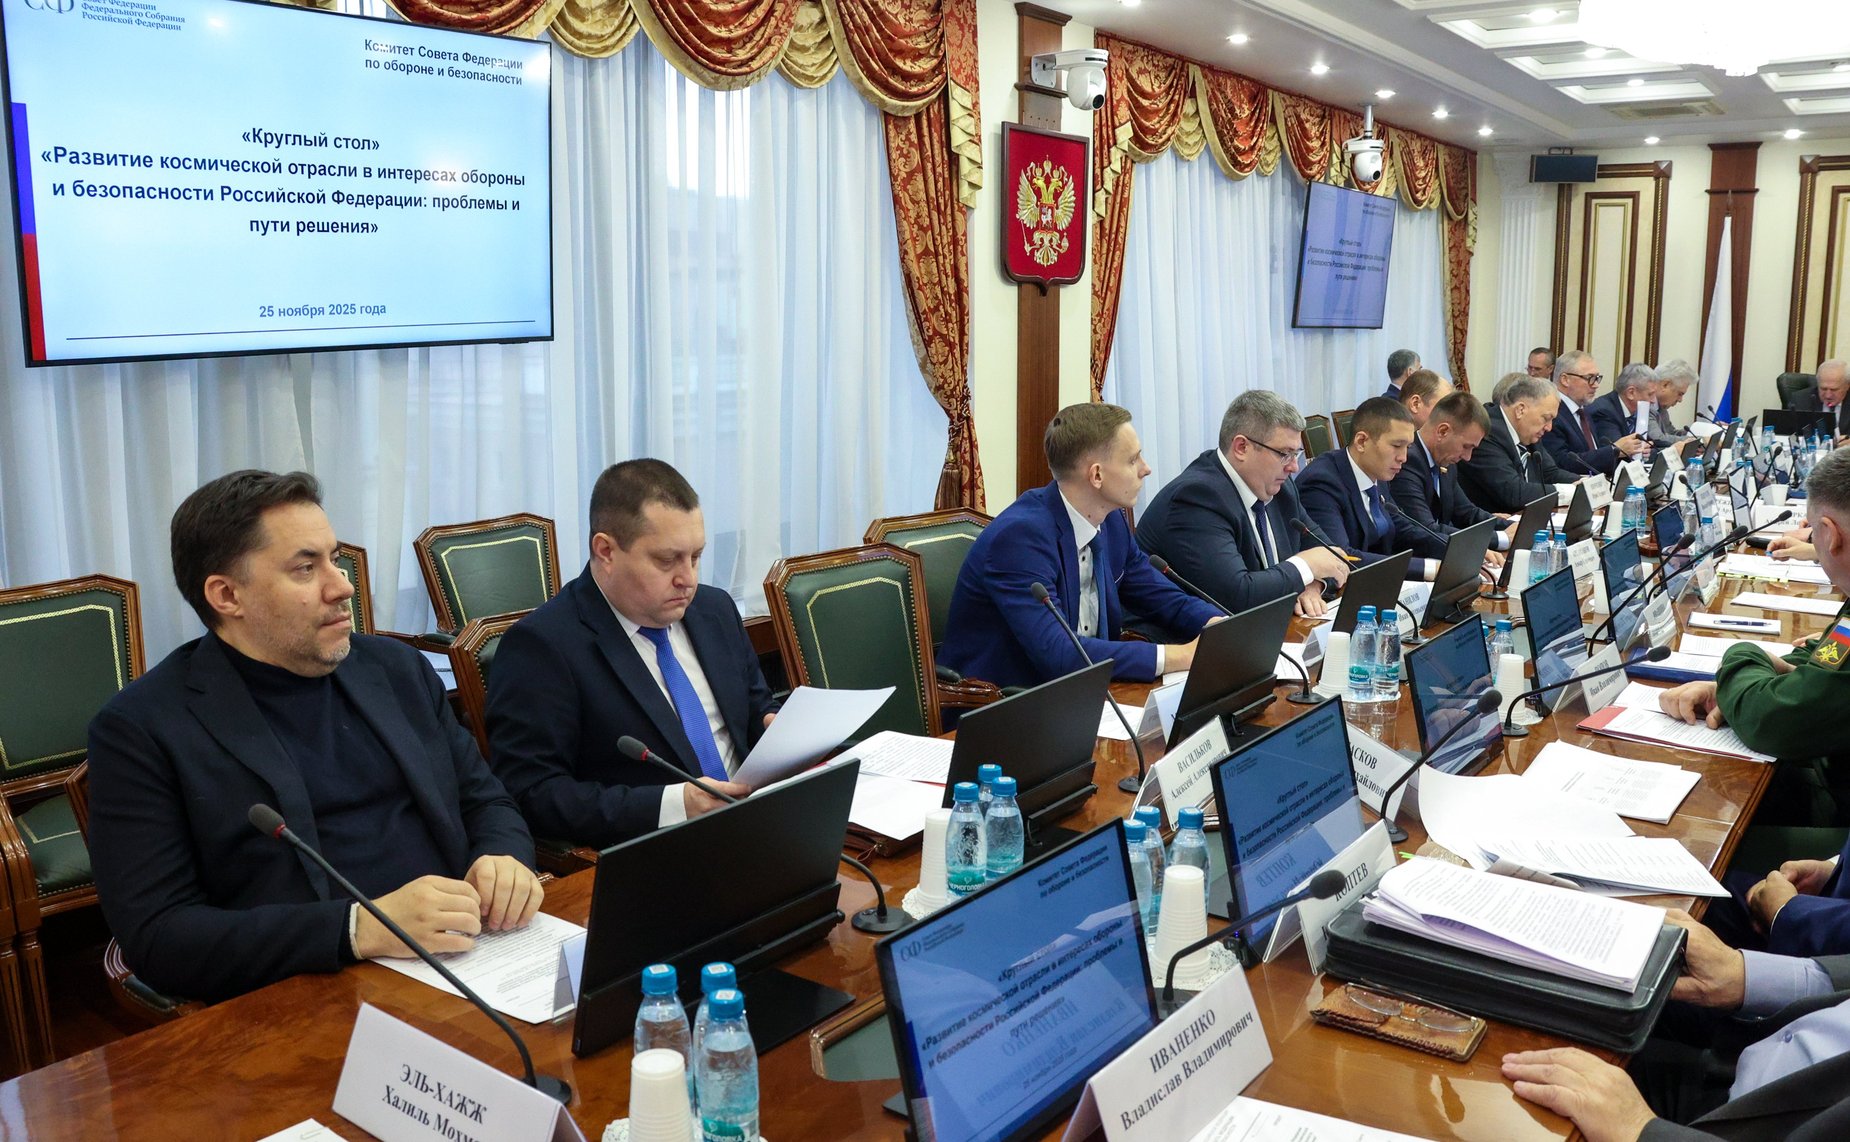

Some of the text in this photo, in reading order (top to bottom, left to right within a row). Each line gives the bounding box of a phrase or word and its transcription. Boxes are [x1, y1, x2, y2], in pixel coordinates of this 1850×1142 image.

[81, 3, 186, 24] Федерального Собрания
[82, 11, 182, 31] Российской Федерации
[418, 45, 459, 62] Совета
[365, 59, 523, 85] по обороне и безопасности
[242, 127, 380, 150] «Круглый стол»
[41, 146, 526, 187] «Развитие космической отрасли в интересах обороны
[52, 179, 520, 211] и безопасности Российской Федерации: проблемы и
[250, 219, 379, 236] пути решения»
[259, 303, 387, 319] 25 ноября 2025 года
[1150, 1008, 1216, 1074] ИВАНЕНКО
[1120, 1073, 1182, 1132] Владислав
[1181, 1011, 1254, 1082] Владимирович
[382, 1084, 430, 1127] Халиль
[400, 1063, 488, 1126] ЭЛЬ-ХАЖЖ
